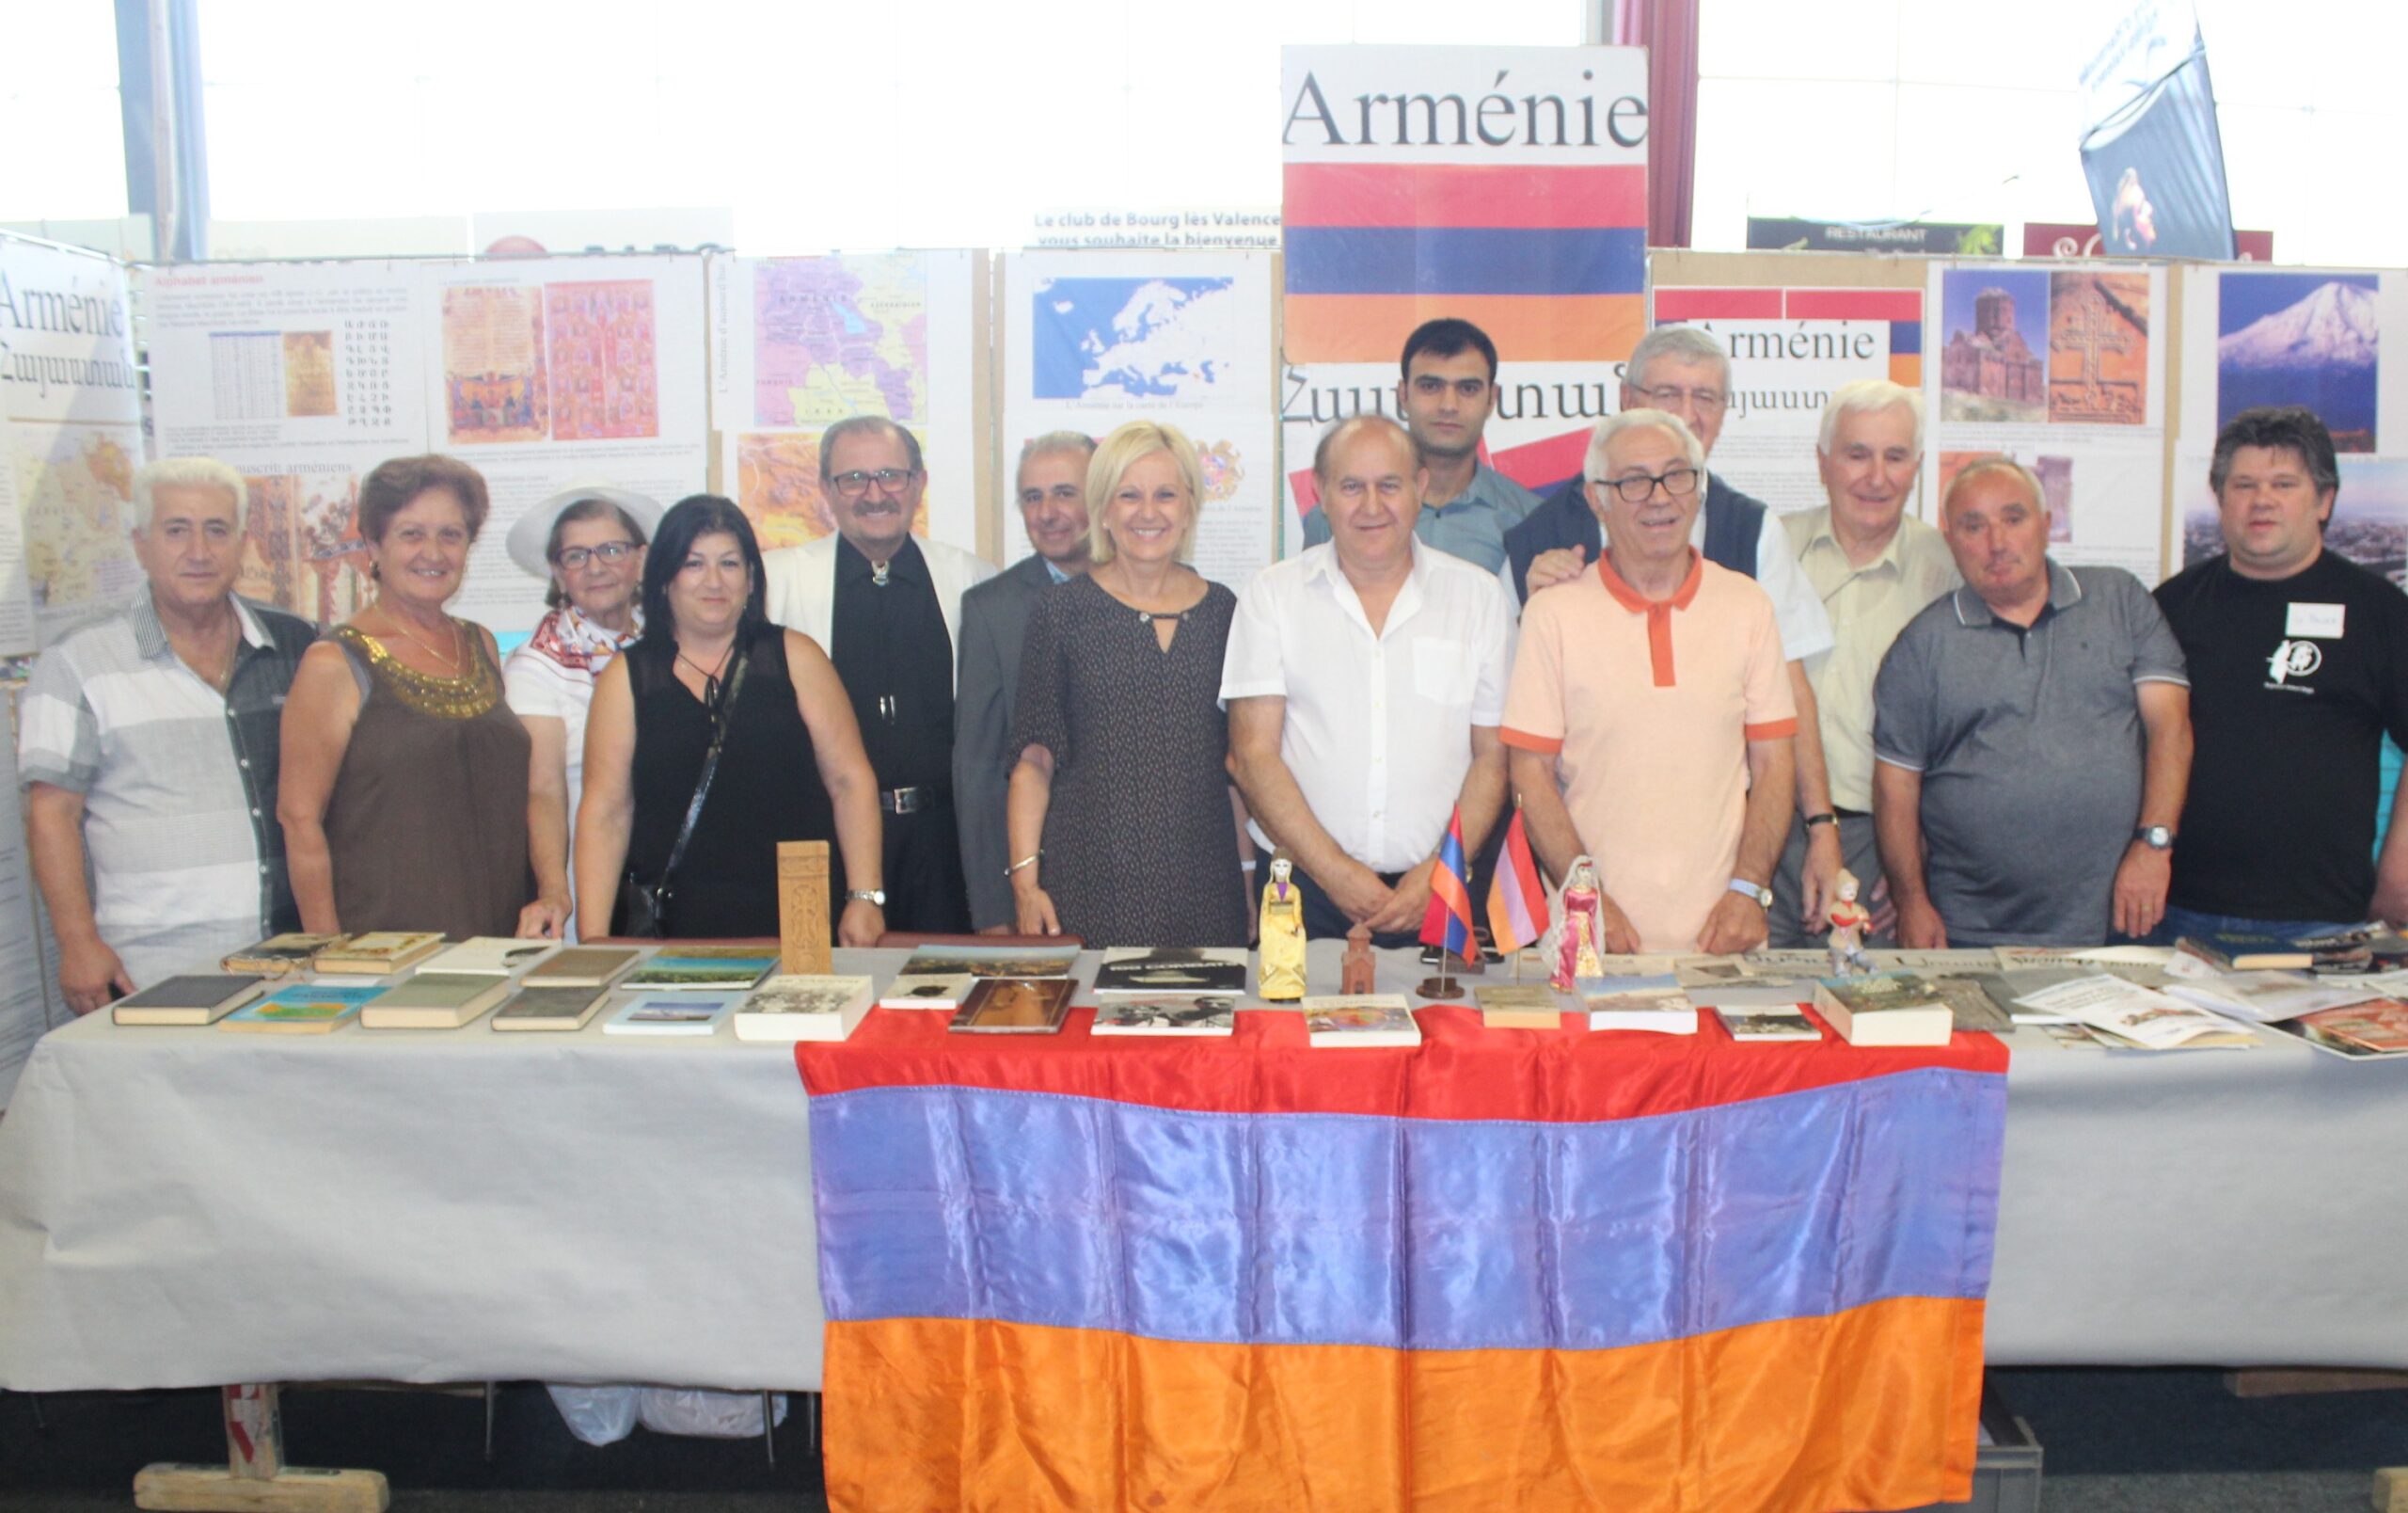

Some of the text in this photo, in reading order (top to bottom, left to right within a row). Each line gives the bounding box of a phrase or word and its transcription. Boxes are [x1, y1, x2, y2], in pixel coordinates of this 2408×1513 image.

[1281, 70, 1649, 148] Arménie
[1035, 215, 1054, 227] Le
[1058, 213, 1095, 227] club
[1101, 213, 1120, 227] de
[1126, 213, 1180, 229] Bourg
[1212, 213, 1281, 226] Valence
[1825, 226, 1927, 242] RESTAURANT
[1038, 232, 1277, 247] vous souhaite la bienvenue
[0, 268, 124, 337] Arménie
[1703, 320, 1876, 359] rménie
